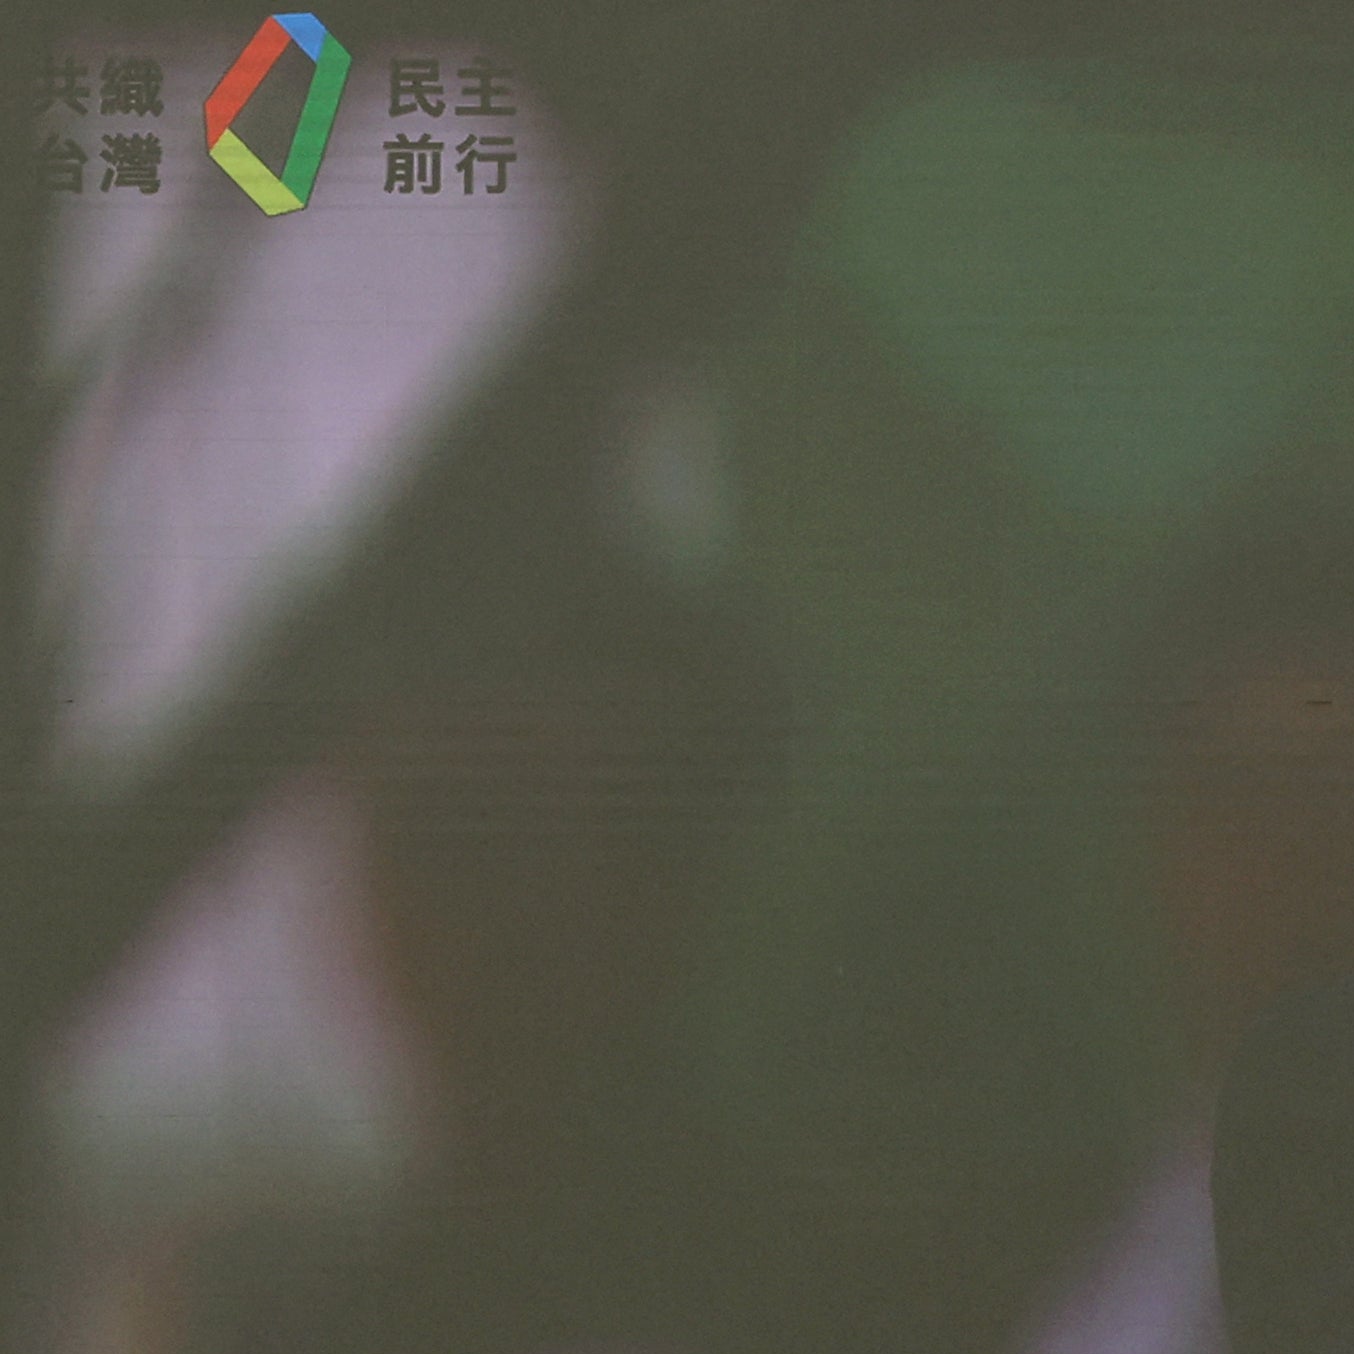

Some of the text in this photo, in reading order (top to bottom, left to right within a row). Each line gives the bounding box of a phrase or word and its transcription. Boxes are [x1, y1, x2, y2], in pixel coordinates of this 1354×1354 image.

[389, 57, 517, 118] 民主
[34, 132, 161, 194] 台灣
[383, 133, 517, 194] 前行
